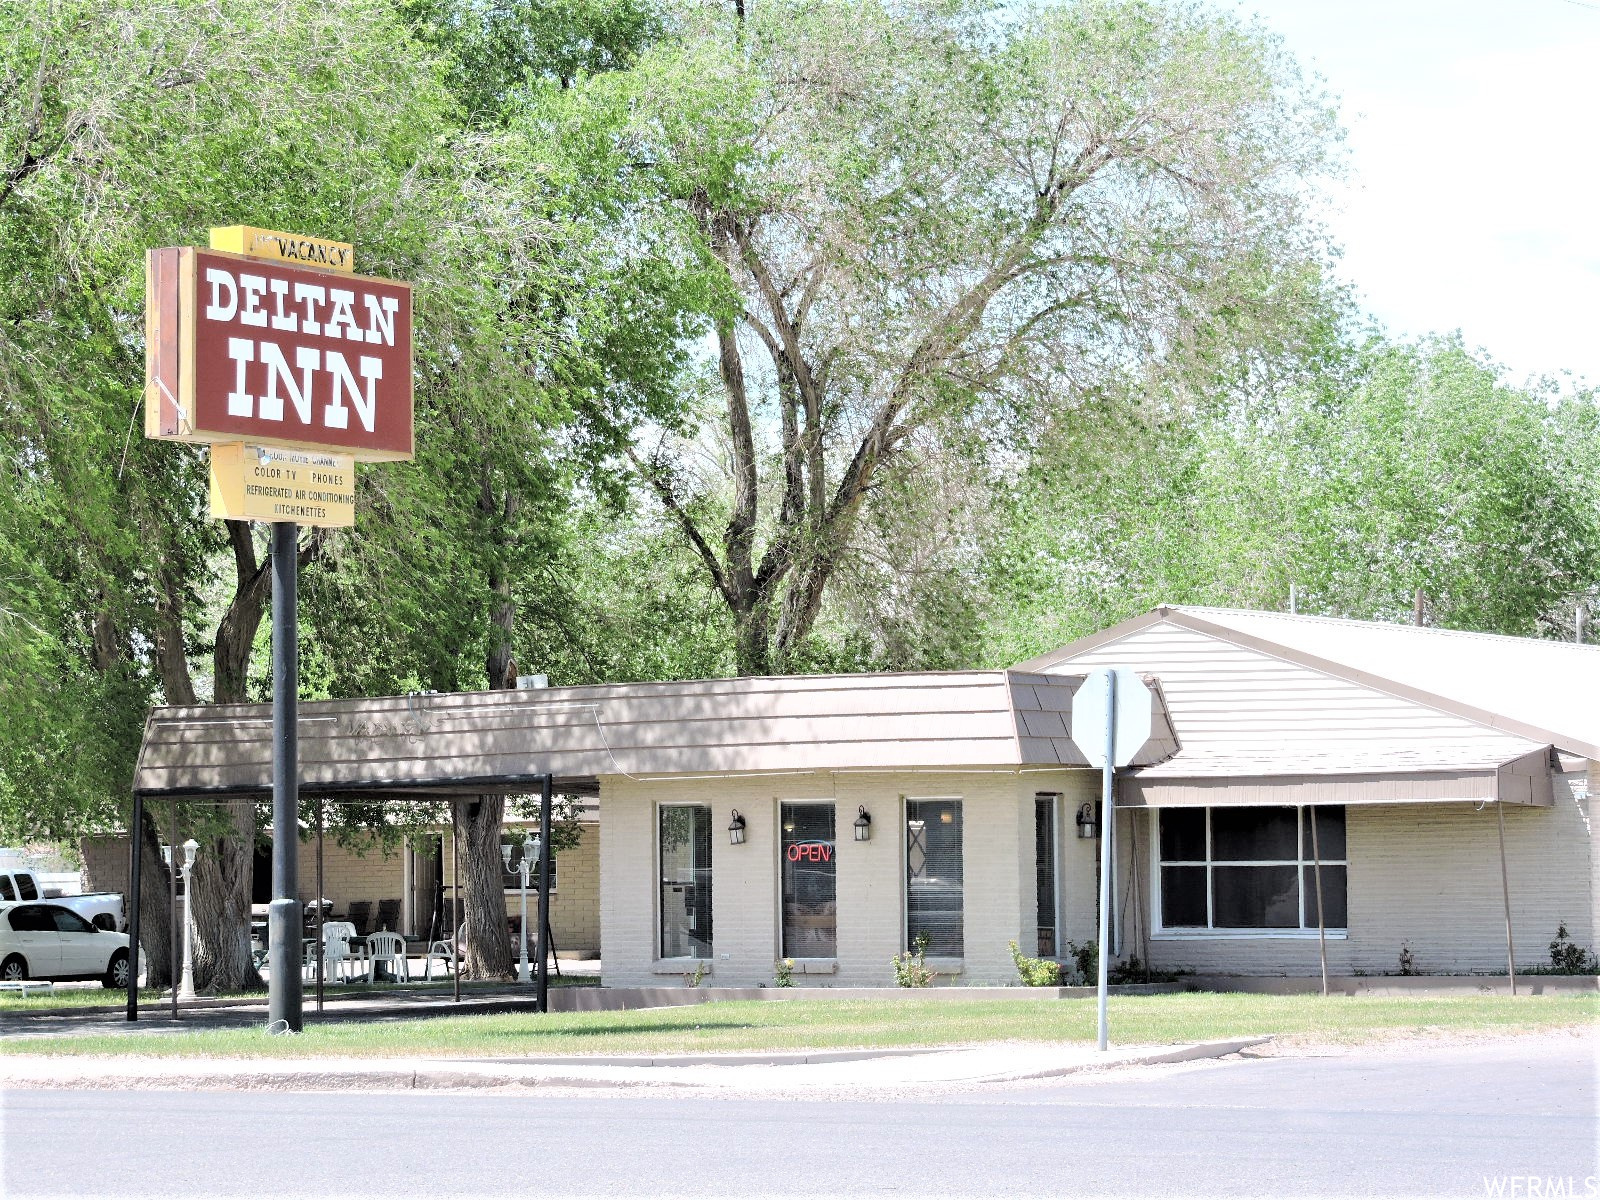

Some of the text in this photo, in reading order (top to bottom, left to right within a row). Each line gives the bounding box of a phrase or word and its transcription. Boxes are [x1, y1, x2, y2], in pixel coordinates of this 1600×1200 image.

[277, 238, 348, 266] VACANCY
[206, 268, 398, 346] DELTAN
[228, 337, 382, 433] INN
[254, 466, 343, 486] COLOR TV PHONES
[246, 484, 354, 504] REFRIGERATED AIR CONDITIONING
[274, 503, 326, 518] KITCHENETTES
[788, 844, 830, 862] OPEN
